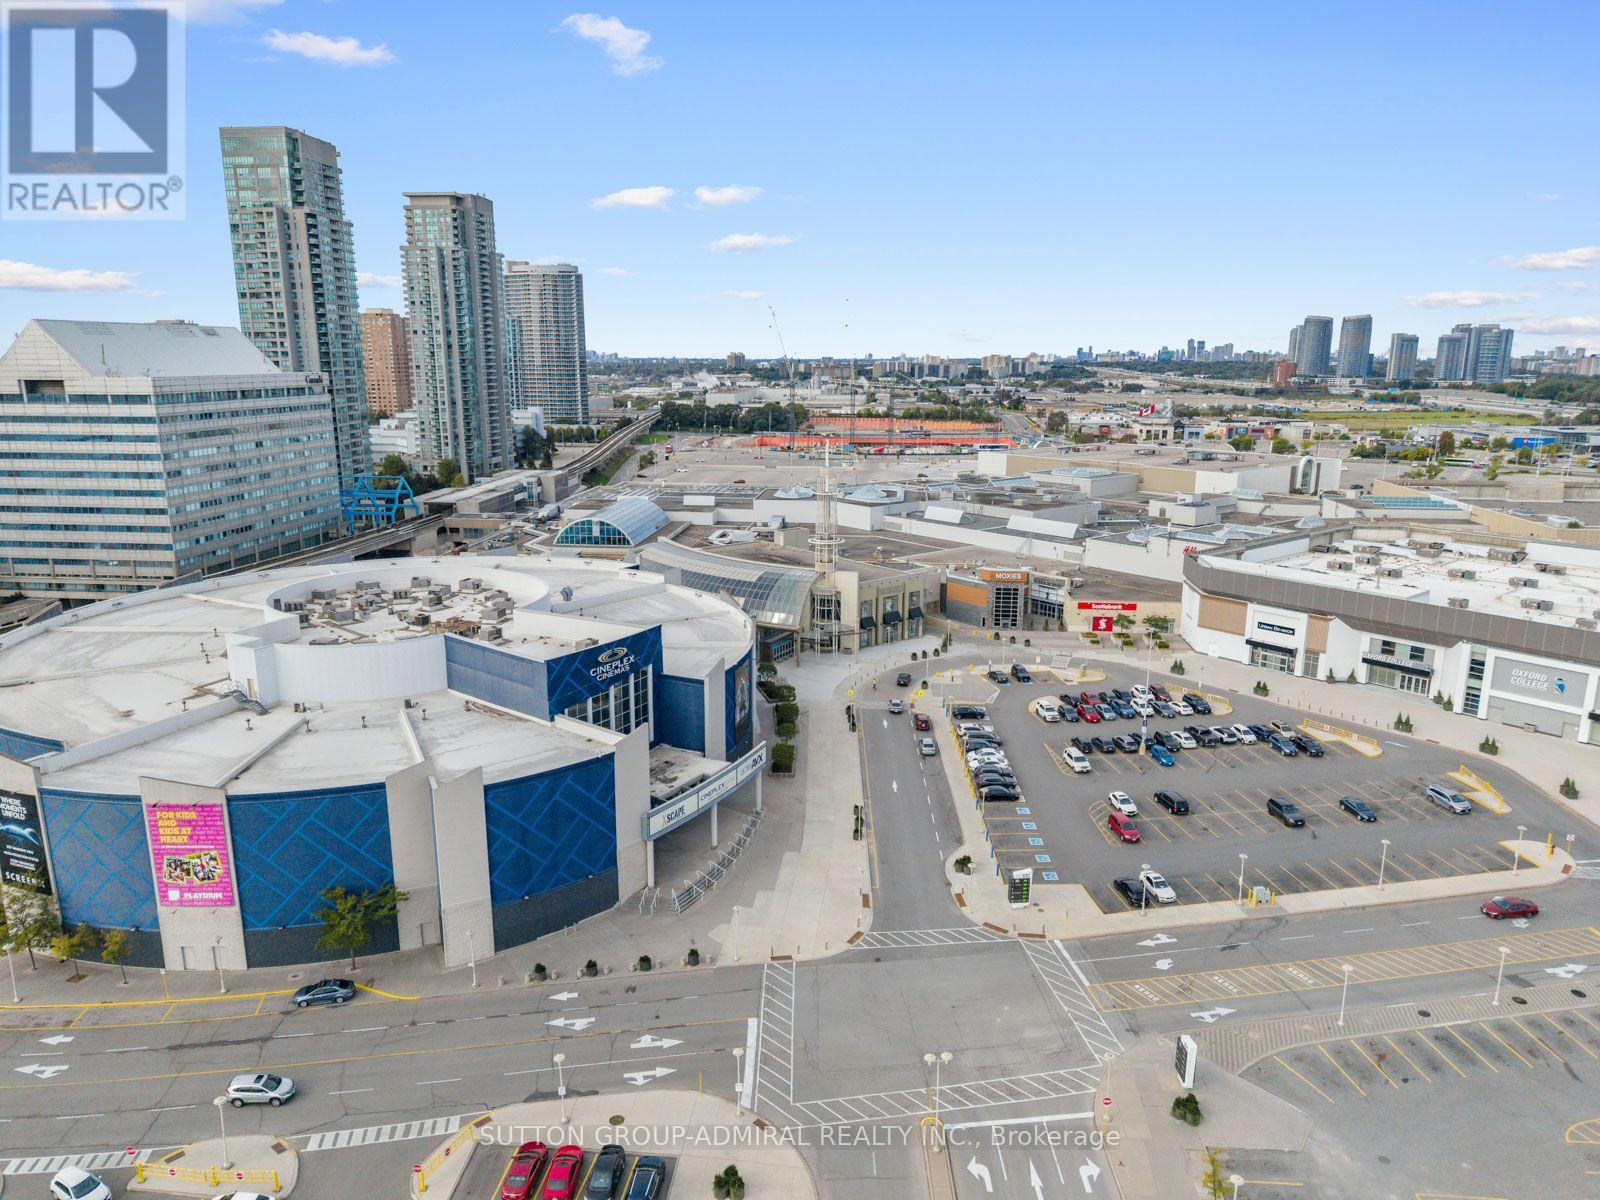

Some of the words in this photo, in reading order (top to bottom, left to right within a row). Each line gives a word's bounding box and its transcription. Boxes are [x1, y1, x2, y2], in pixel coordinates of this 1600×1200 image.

[1361, 652, 1387, 662] OXFORD
[590, 655, 635, 677] CINEPLEX
[596, 664, 630, 682] CINEMAS
[1511, 668, 1548, 682] OXFORD
[1510, 676, 1551, 690] COLLEGE
[1, 808, 26, 821] UNFOLD
[156, 811, 175, 819] FOR
[175, 811, 197, 819] KIDS
[159, 827, 180, 835] KIDS
[181, 827, 192, 835] AT
[160, 835, 188, 843] HEART
[184, 892, 223, 900] PLAYDIUM
